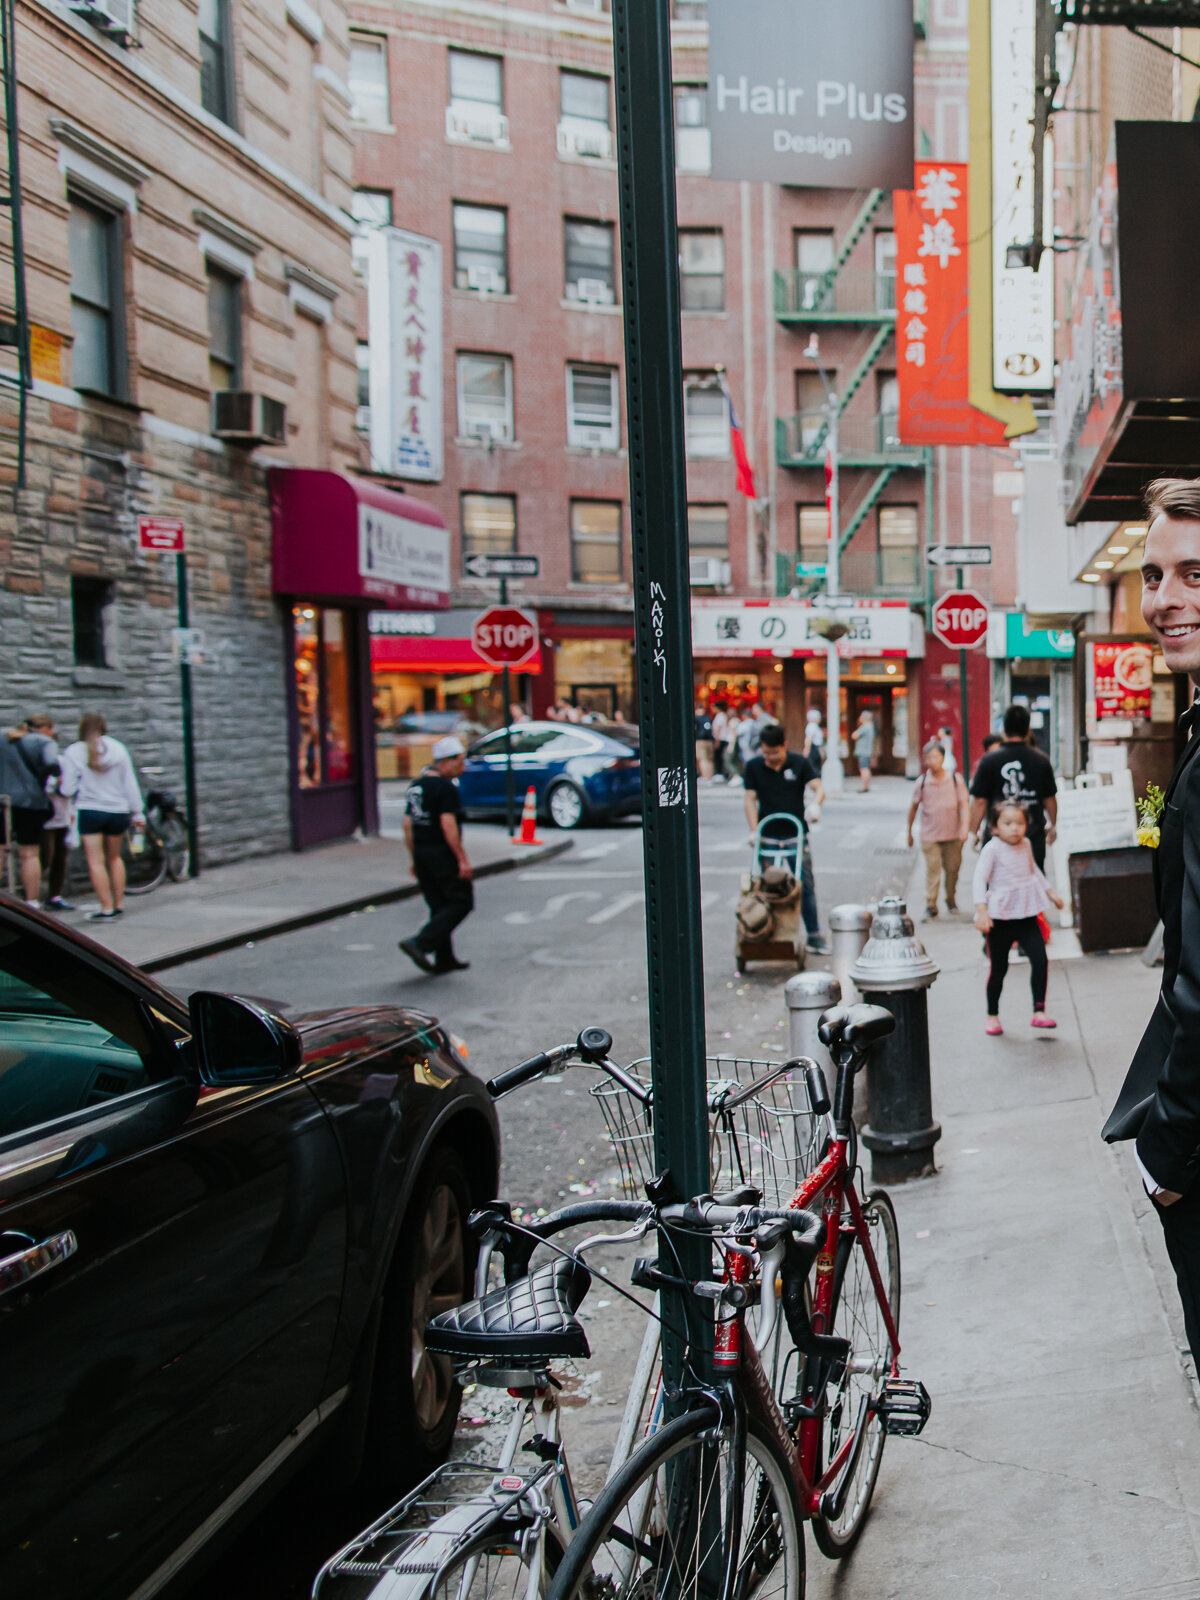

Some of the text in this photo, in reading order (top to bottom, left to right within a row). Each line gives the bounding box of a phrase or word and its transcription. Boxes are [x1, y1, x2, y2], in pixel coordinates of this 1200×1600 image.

[717, 74, 907, 123] Hair Plus
[773, 129, 852, 159] Design
[916, 168, 961, 269] 華埠
[937, 608, 986, 631] STOP
[477, 624, 533, 649] STOP
